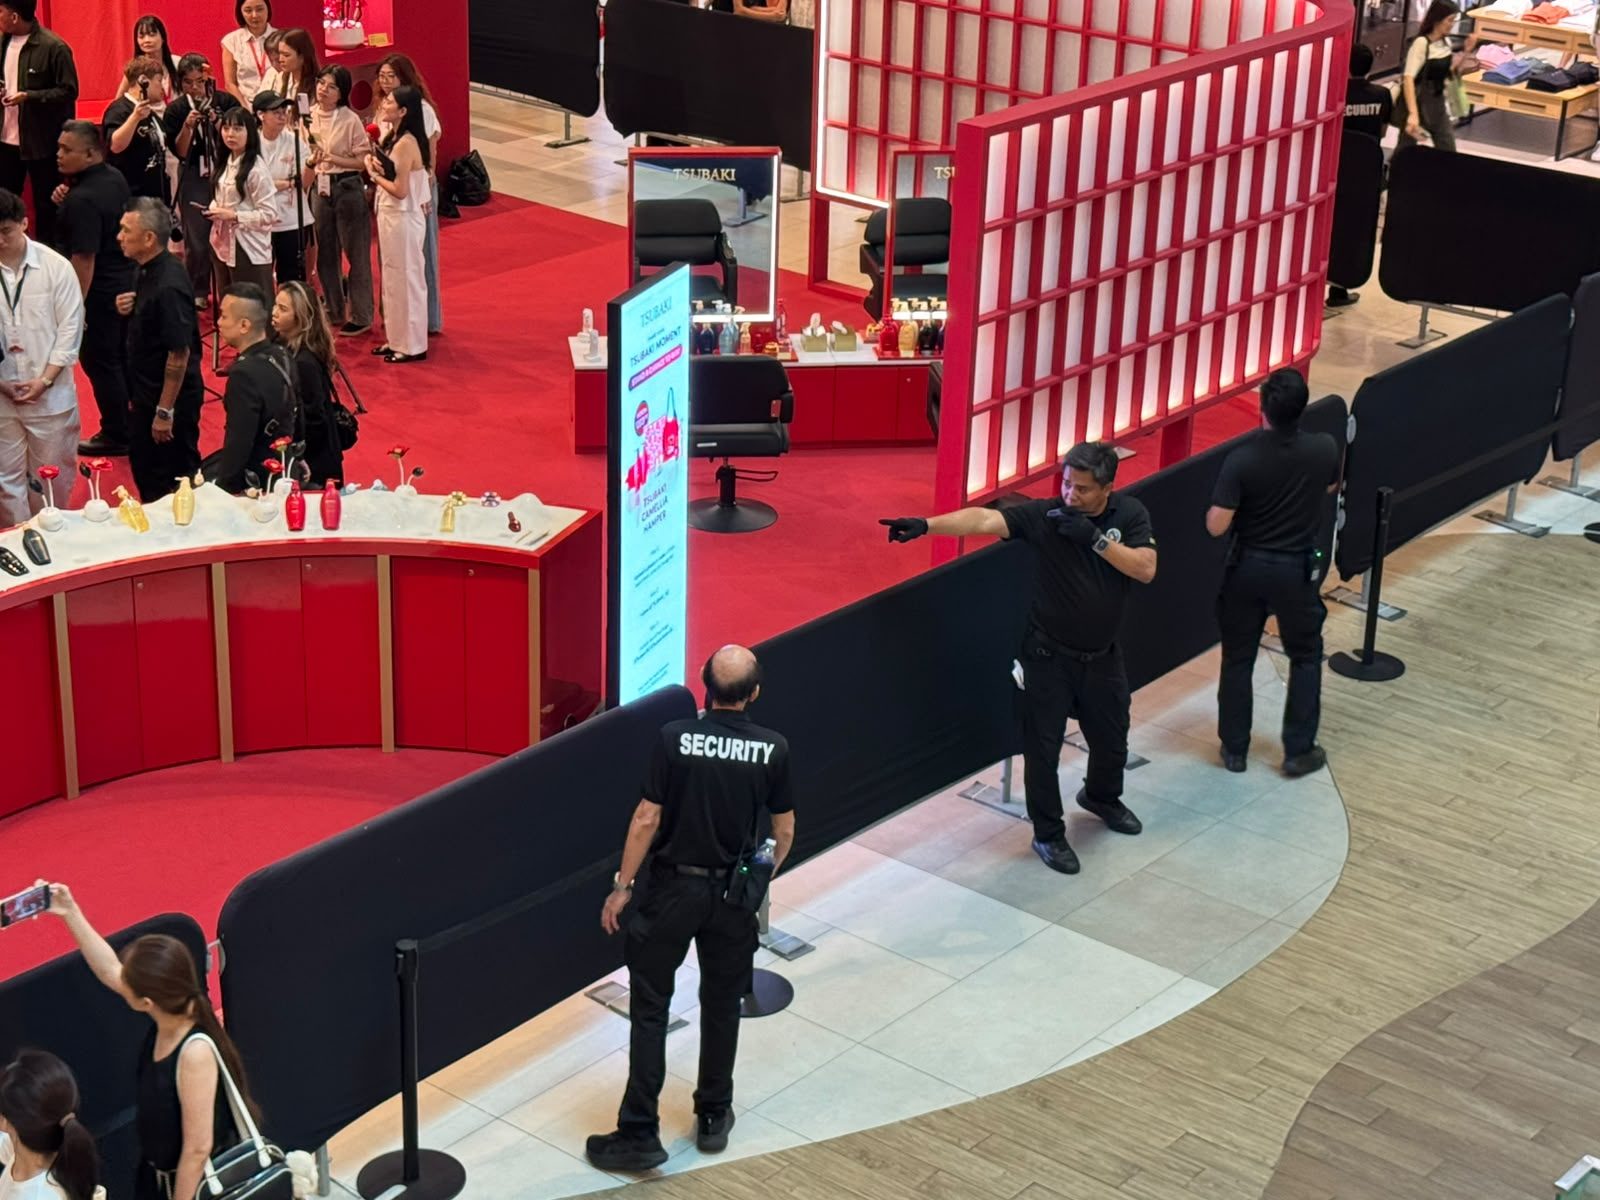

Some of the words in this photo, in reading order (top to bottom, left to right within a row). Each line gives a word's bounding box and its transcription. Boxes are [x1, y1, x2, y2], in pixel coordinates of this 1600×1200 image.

[1343, 103, 1382, 117] CURITY
[672, 168, 736, 181] TSUBAKI
[641, 296, 672, 327] TSUBAKI
[656, 325, 681, 351] MOMENT
[679, 732, 775, 764] SECURITY
